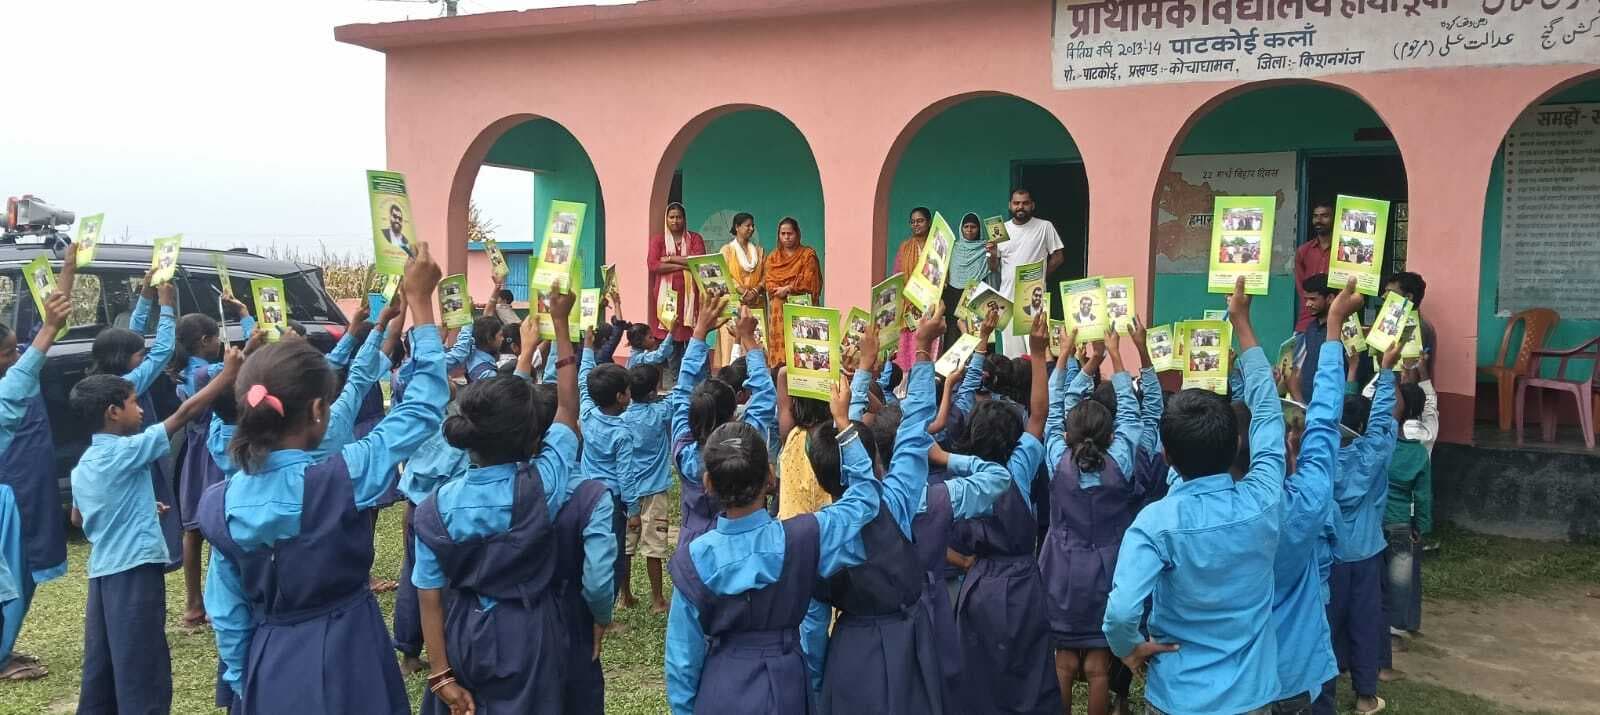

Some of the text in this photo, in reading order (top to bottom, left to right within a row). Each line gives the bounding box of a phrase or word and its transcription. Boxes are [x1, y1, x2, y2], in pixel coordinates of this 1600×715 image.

[1169, 26, 1259, 55] पाटकोई
[1463, 30, 1514, 50] عدالت
[1299, 47, 1365, 69] किशनगंज
